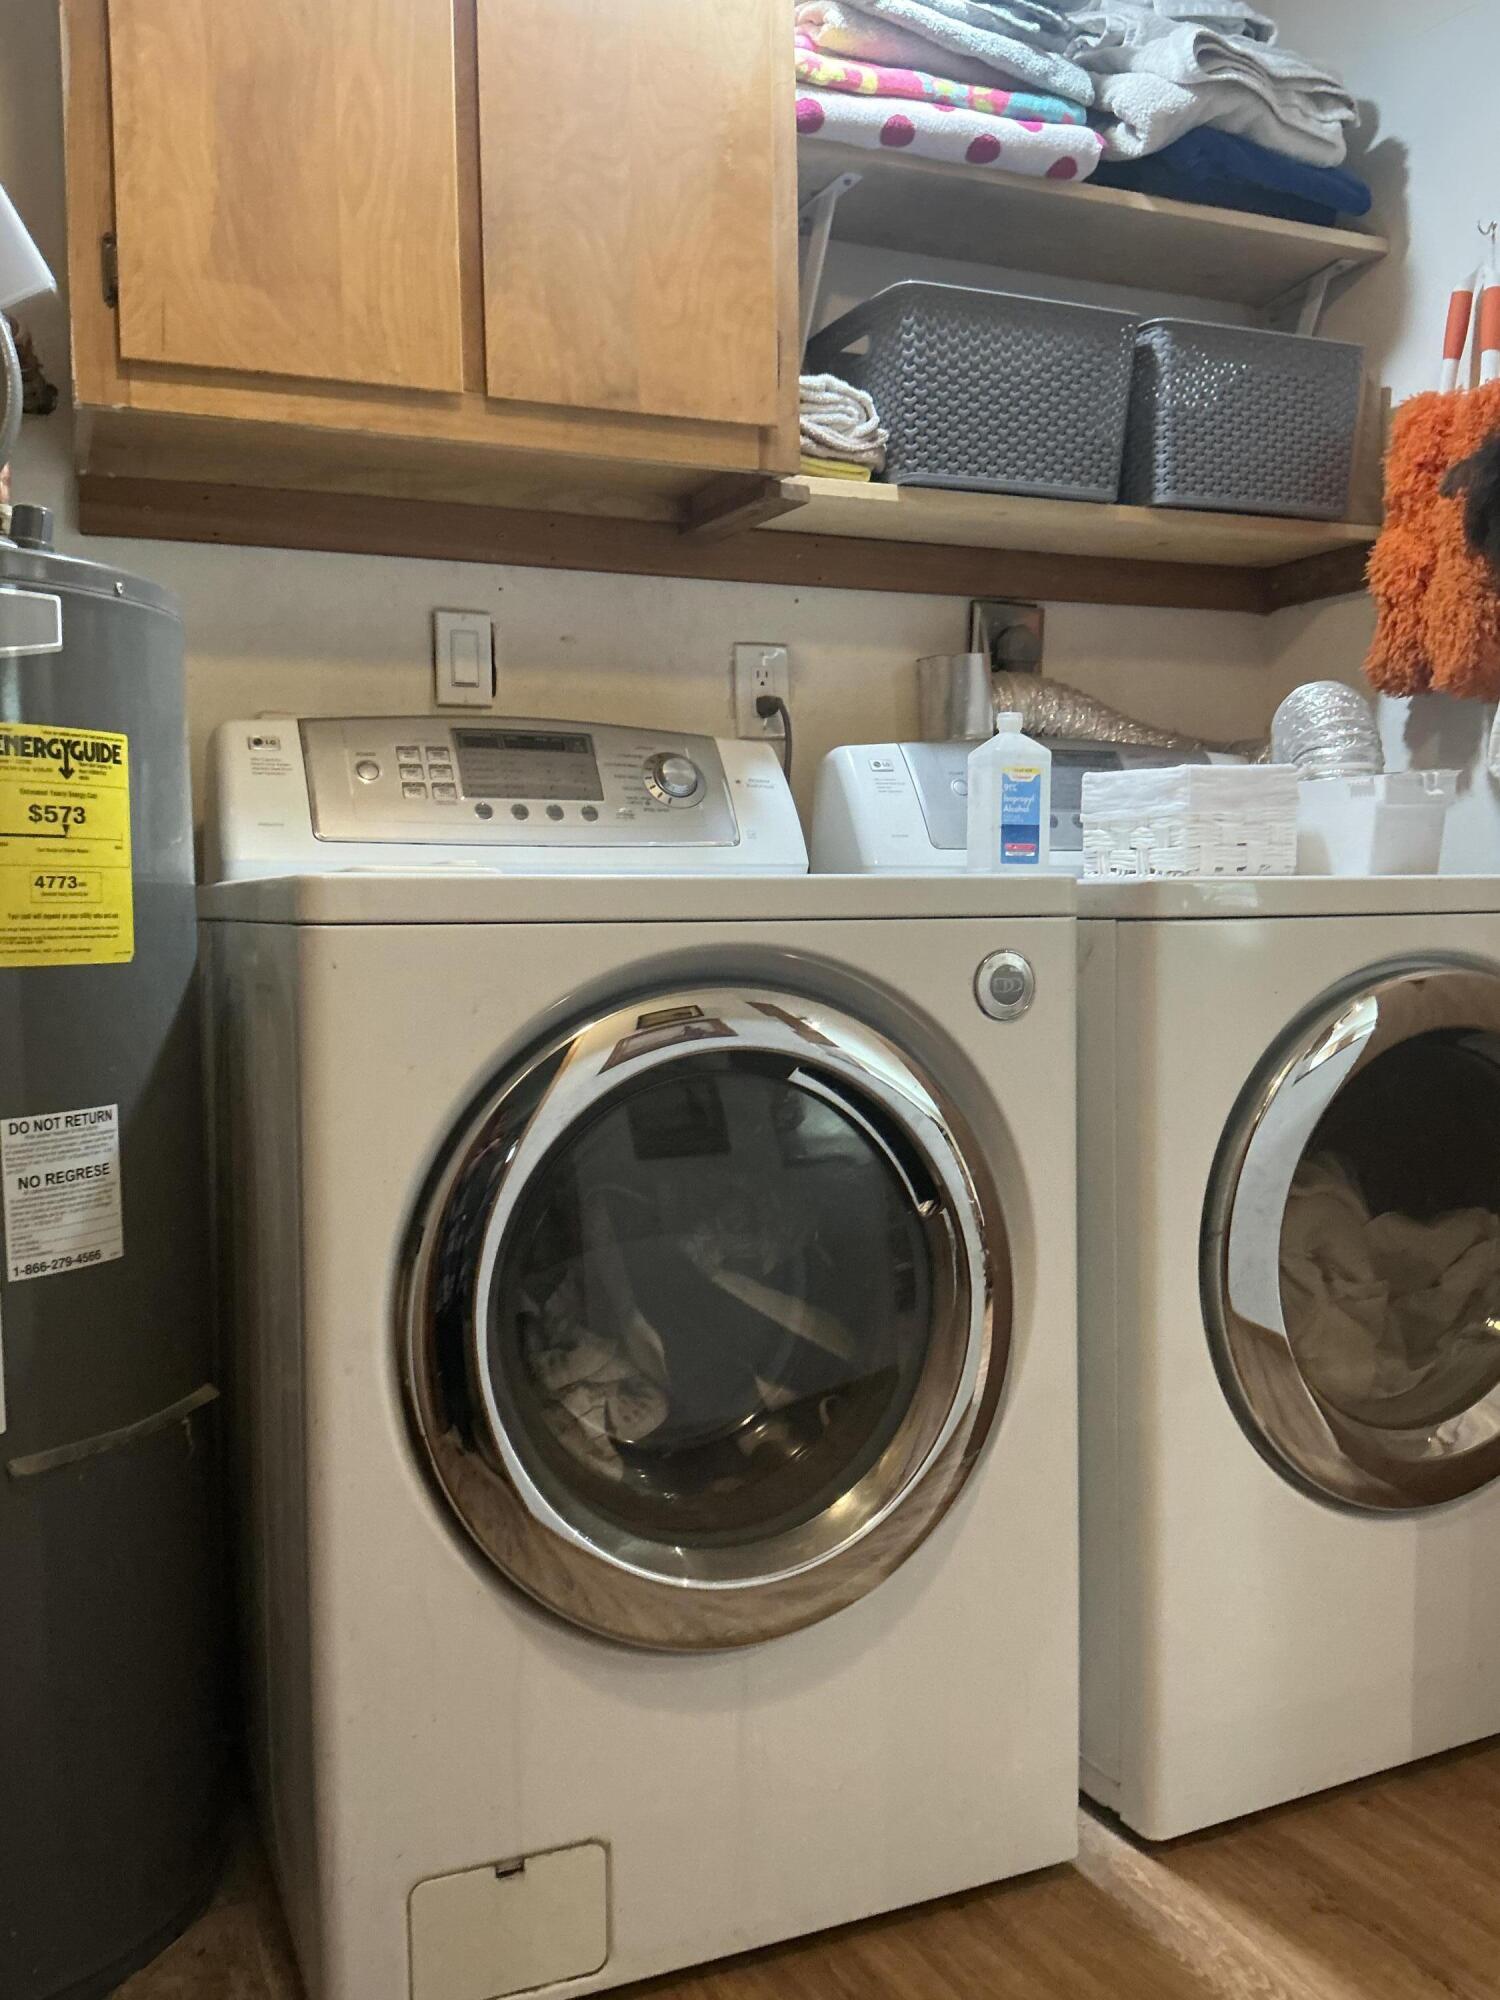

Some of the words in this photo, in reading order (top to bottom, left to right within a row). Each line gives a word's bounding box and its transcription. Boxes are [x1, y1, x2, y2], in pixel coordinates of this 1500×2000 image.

[28, 803, 86, 825] $573
[34, 875, 77, 889] 4773
[8, 1121, 30, 1136] DO
[33, 1116, 61, 1132] NOT
[65, 1109, 113, 1128] RETURN
[17, 1174, 41, 1190] NO
[45, 1162, 110, 1186] REGRESE
